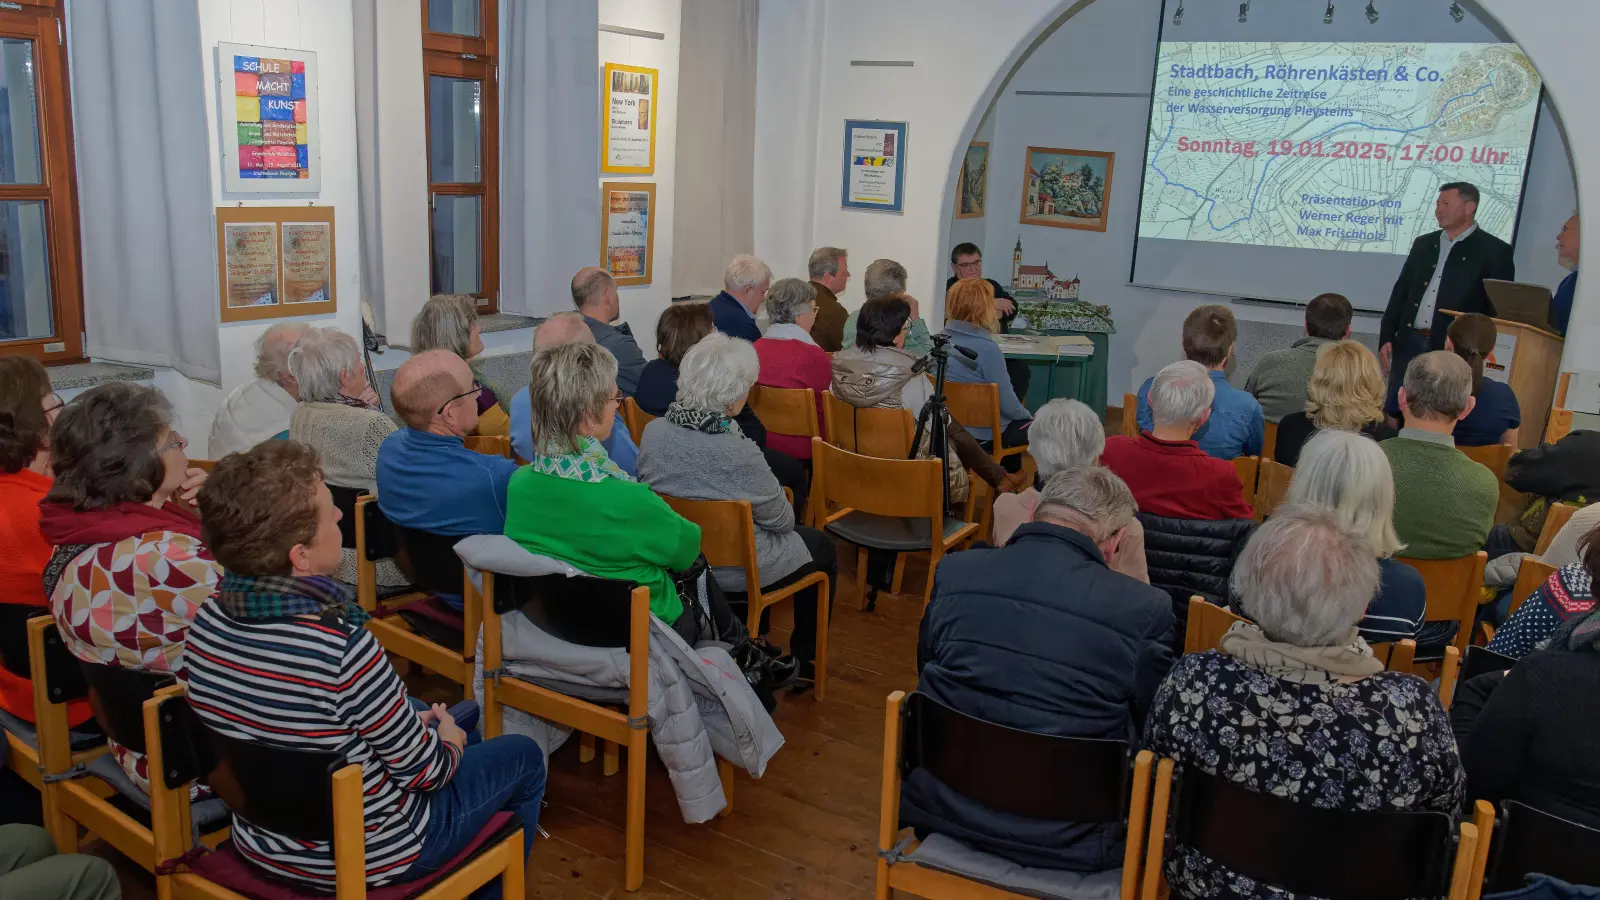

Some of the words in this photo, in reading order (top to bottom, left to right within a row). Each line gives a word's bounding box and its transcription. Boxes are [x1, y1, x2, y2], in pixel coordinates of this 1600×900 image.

[242, 62, 279, 73] SCHULE
[1170, 63, 1258, 82] Stadtbach,
[1264, 64, 1388, 81] Röhrenkästen
[1394, 66, 1408, 82] &
[1415, 66, 1445, 82] Co.
[256, 81, 290, 92] MACHT
[1168, 86, 1191, 96] Eine
[1194, 88, 1273, 98] geschichtliche
[1276, 88, 1327, 99] Zeitreise
[268, 100, 300, 110] KUNST
[1166, 103, 1184, 112] der
[1188, 104, 1291, 117] Wasserversorgung
[1294, 106, 1353, 118] Pleysteins
[1177, 136, 1258, 158] Sonntag,
[1267, 140, 1392, 162] 19.01.2025,
[1400, 144, 1464, 162] 17:00
[1471, 146, 1510, 164] Uhr
[1302, 194, 1376, 207] Präsentation
[1300, 210, 1342, 220] Werner
[1345, 213, 1380, 225] Reger
[1384, 215, 1404, 225] mit
[1296, 226, 1321, 237] Max
[1325, 227, 1385, 240] Frischholz
